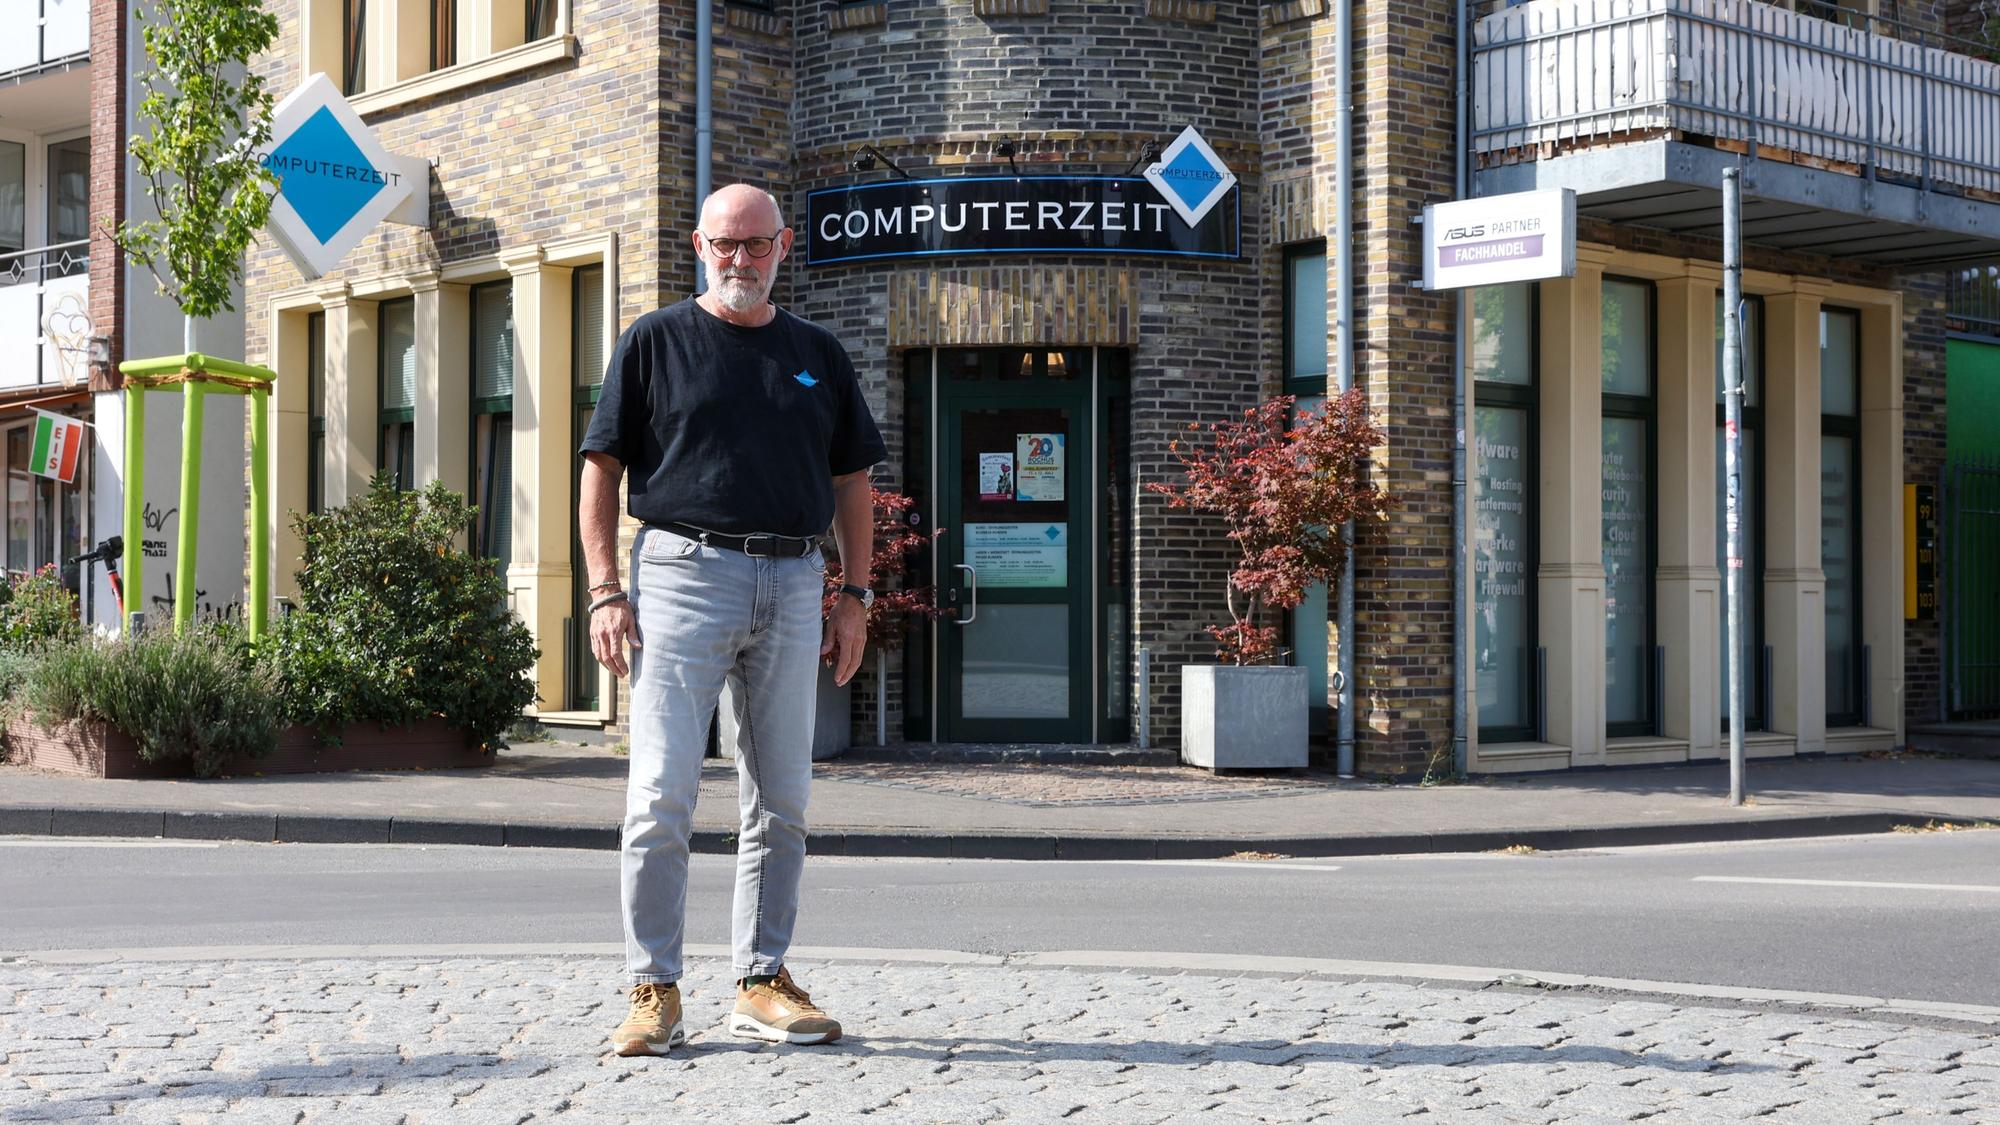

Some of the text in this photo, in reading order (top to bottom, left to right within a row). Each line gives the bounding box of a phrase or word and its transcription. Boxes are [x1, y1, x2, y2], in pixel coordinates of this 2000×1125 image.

[1149, 167, 1231, 180] COMPUTERZEIT
[820, 200, 1171, 242] COMPUTERZEIT
[1444, 217, 1541, 241] ASUS PARTNER
[1455, 242, 1527, 262] FACHHANDEL
[49, 427, 62, 470] EIS
[1028, 437, 1054, 457] 20
[1490, 477, 1522, 494] Hosting
[1919, 504, 1931, 519] 99
[1608, 526, 1637, 541] Cloud
[1481, 578, 1524, 596] Firewall
[1919, 593, 1933, 608] 103
